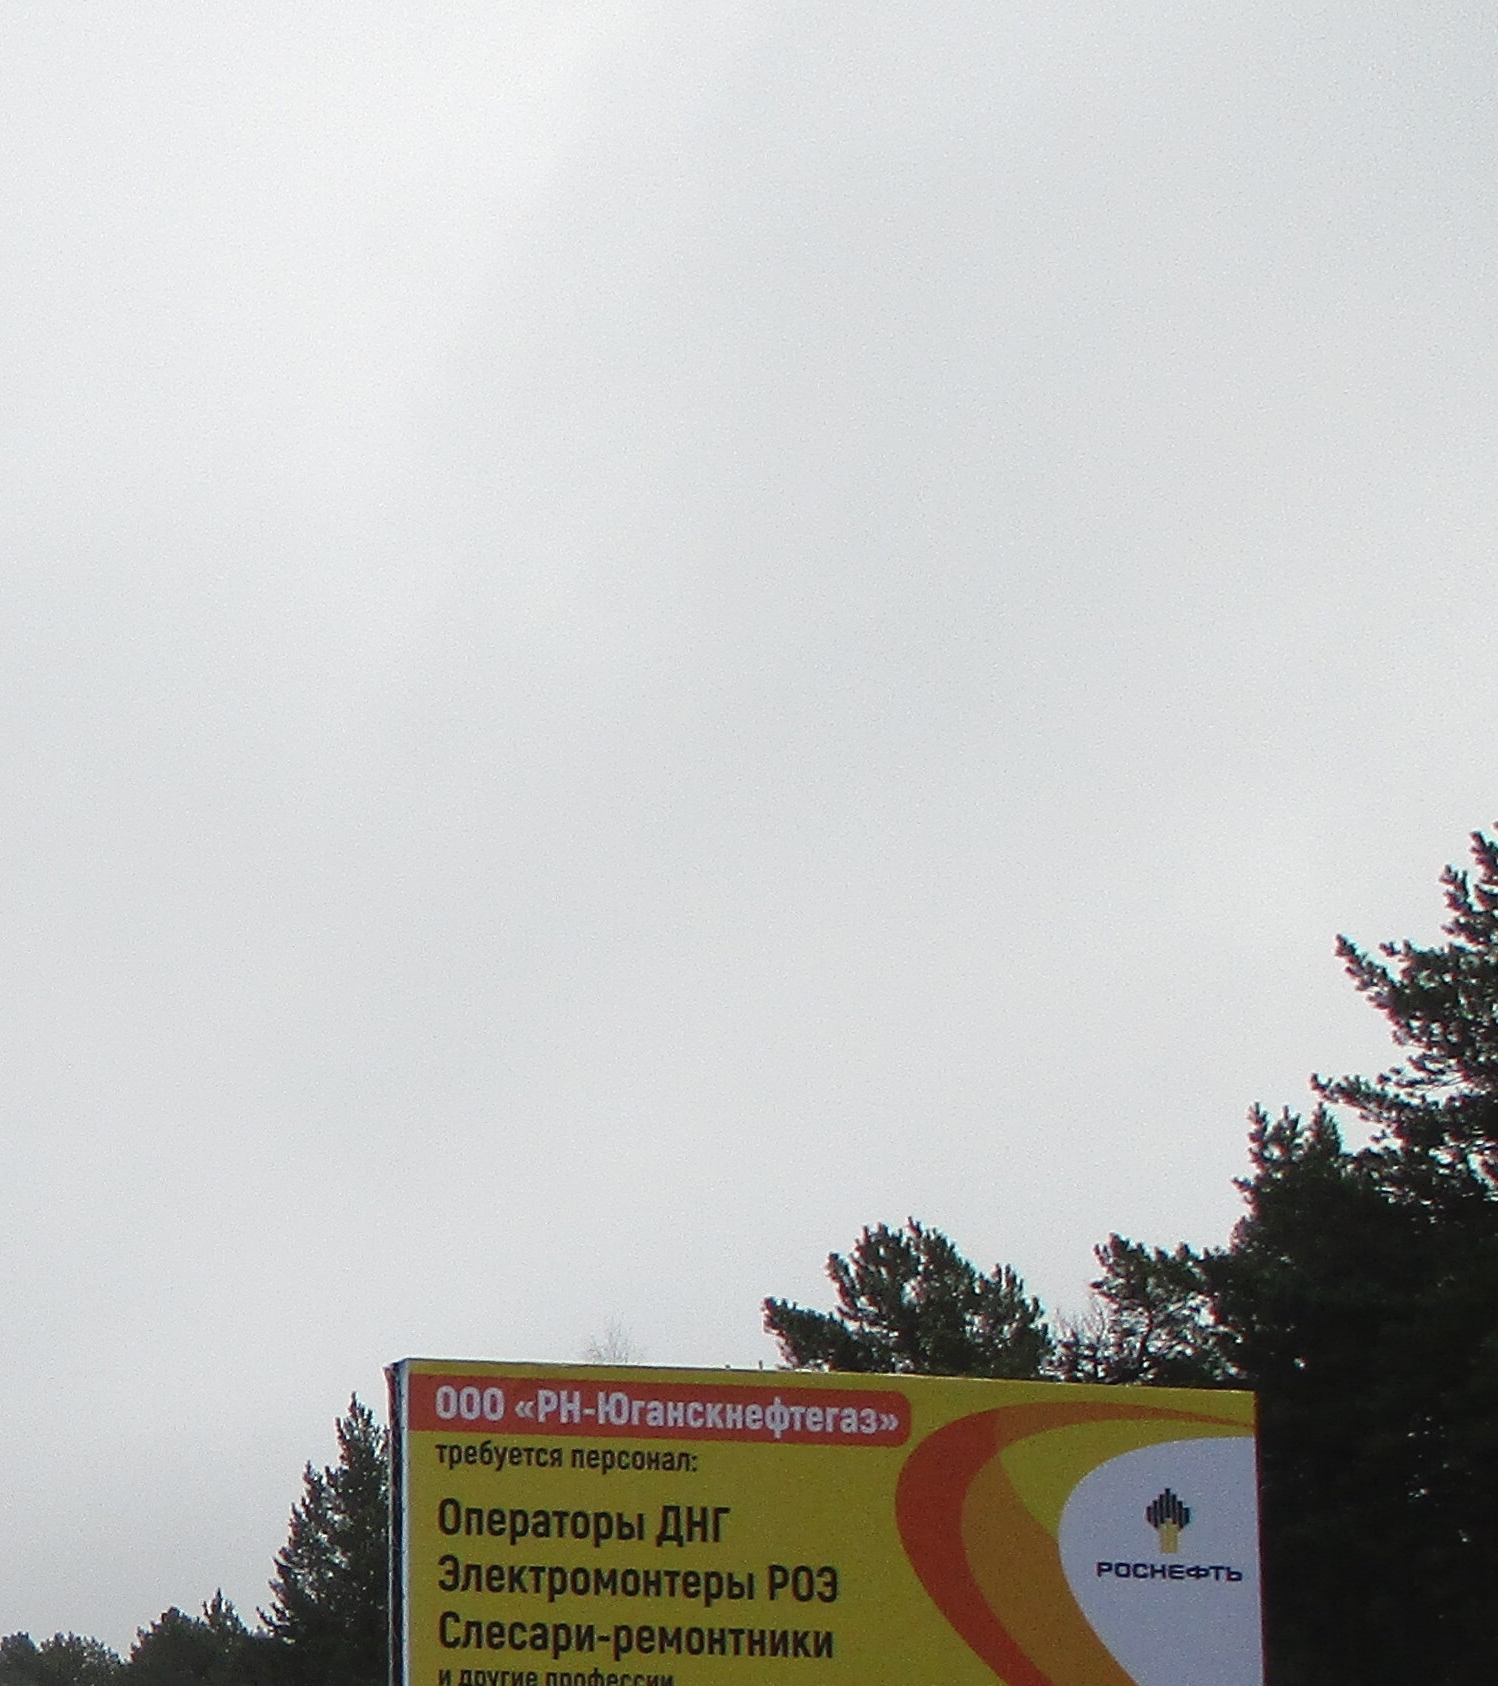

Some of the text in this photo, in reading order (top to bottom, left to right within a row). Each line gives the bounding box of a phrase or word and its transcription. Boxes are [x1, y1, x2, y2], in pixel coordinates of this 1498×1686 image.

[435, 1385, 899, 1439] ООО «РН-Юганскнефтегаз»
[435, 1441, 698, 1473] требуется персонал:
[438, 1499, 731, 1547] Операторы ДНГ
[438, 1555, 839, 1607] Электромонтеры РОЭ
[1097, 1561, 1243, 1583] РОСНЕФТЬ
[439, 1611, 834, 1660] Слесари-ремонтники
[439, 1671, 451, 1686] и
